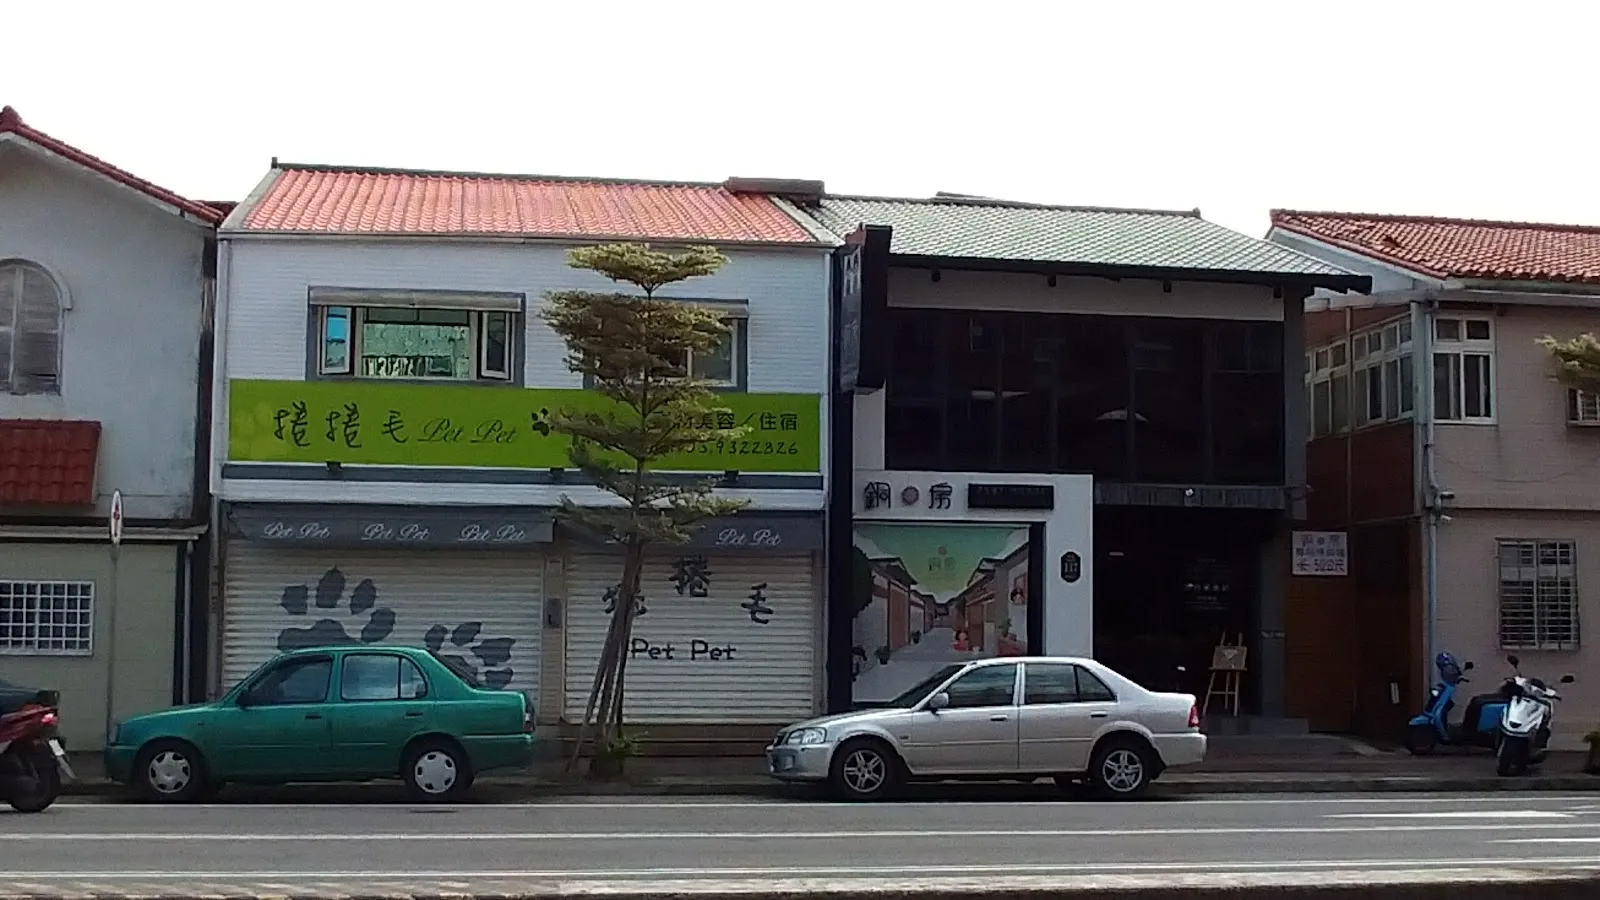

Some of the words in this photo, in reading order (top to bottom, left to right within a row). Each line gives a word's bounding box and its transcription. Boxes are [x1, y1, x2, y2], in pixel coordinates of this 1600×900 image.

[417, 417, 464, 443] Pet
[469, 419, 519, 444] Pet
[262, 521, 293, 539] Pet
[296, 522, 332, 540] Pet
[361, 523, 394, 541] Pet
[396, 523, 431, 541] Pet
[458, 524, 490, 542] Pet
[492, 524, 527, 542] Pet
[715, 528, 746, 546] Pet
[748, 528, 782, 546] Pet
[630, 638, 676, 660] Pet
[690, 639, 737, 661] Pet
